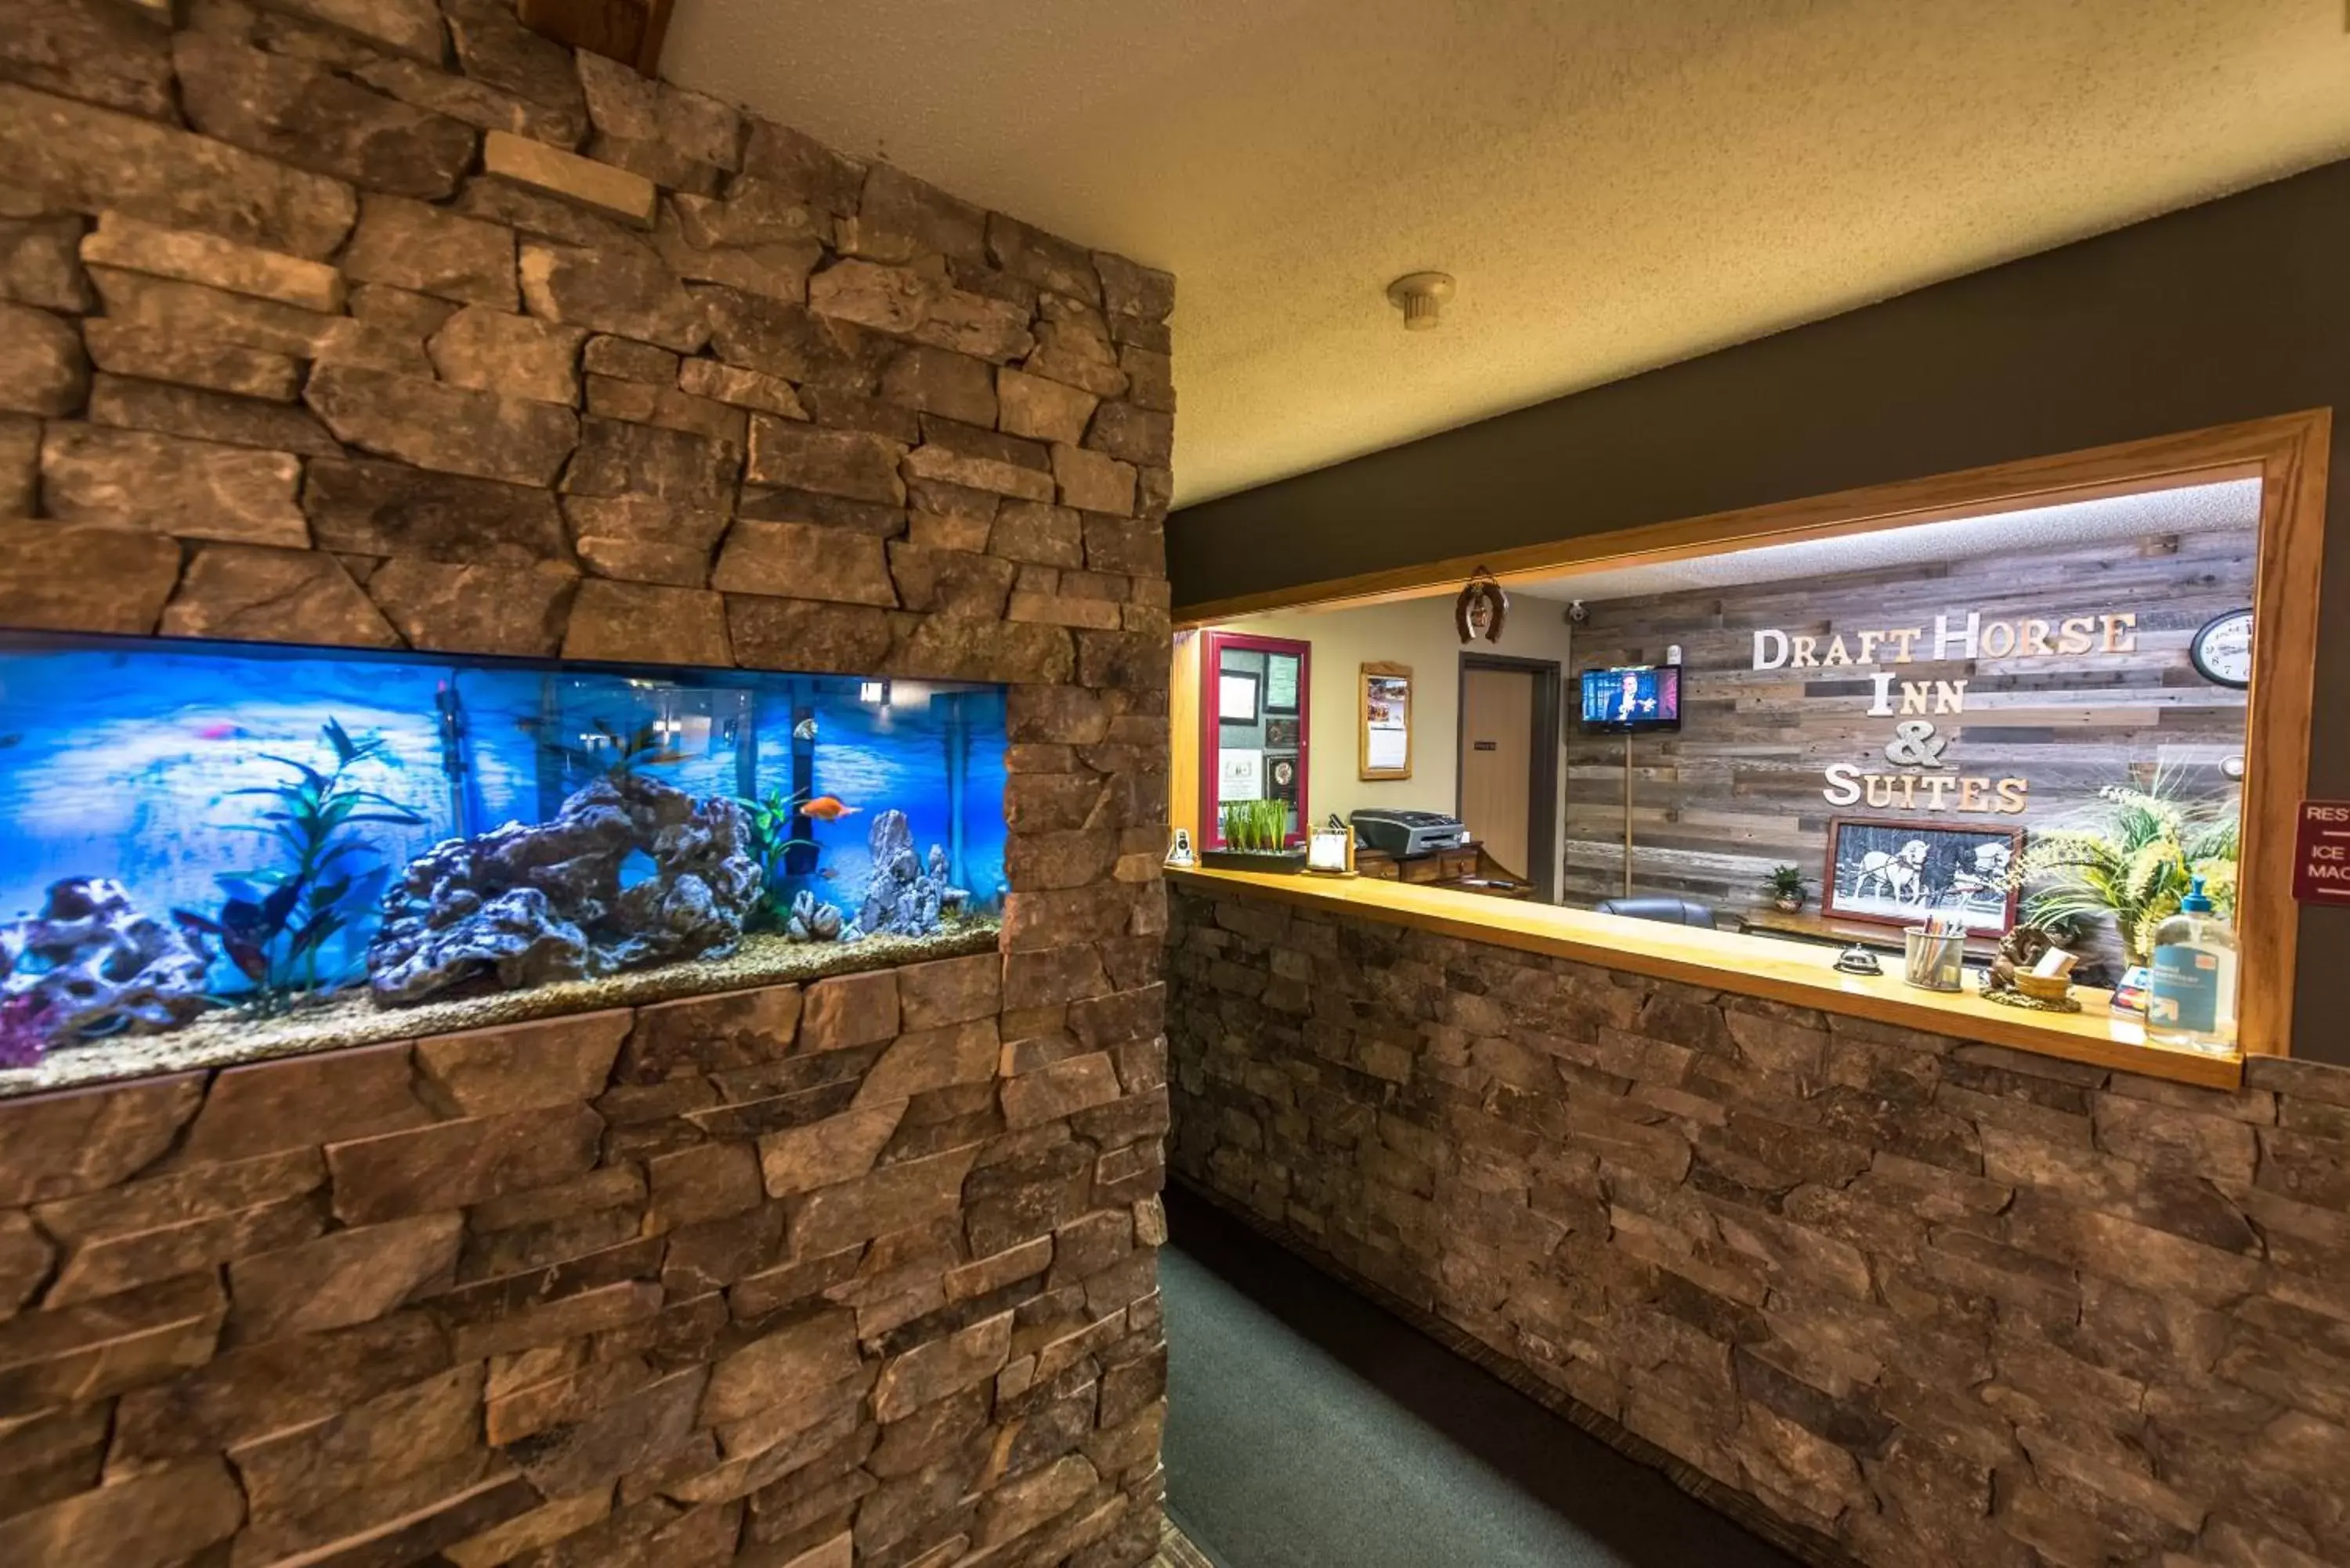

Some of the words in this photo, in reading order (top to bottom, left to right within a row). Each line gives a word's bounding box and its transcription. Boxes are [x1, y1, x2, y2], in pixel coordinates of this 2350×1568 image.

[1753, 627, 1921, 670] DRAFT
[1934, 612, 2137, 658] HORSE
[1867, 672, 1968, 717] INN
[1885, 720, 1946, 768] &
[1823, 763, 2029, 813] SUITES
[2312, 845, 2345, 859] ICE
